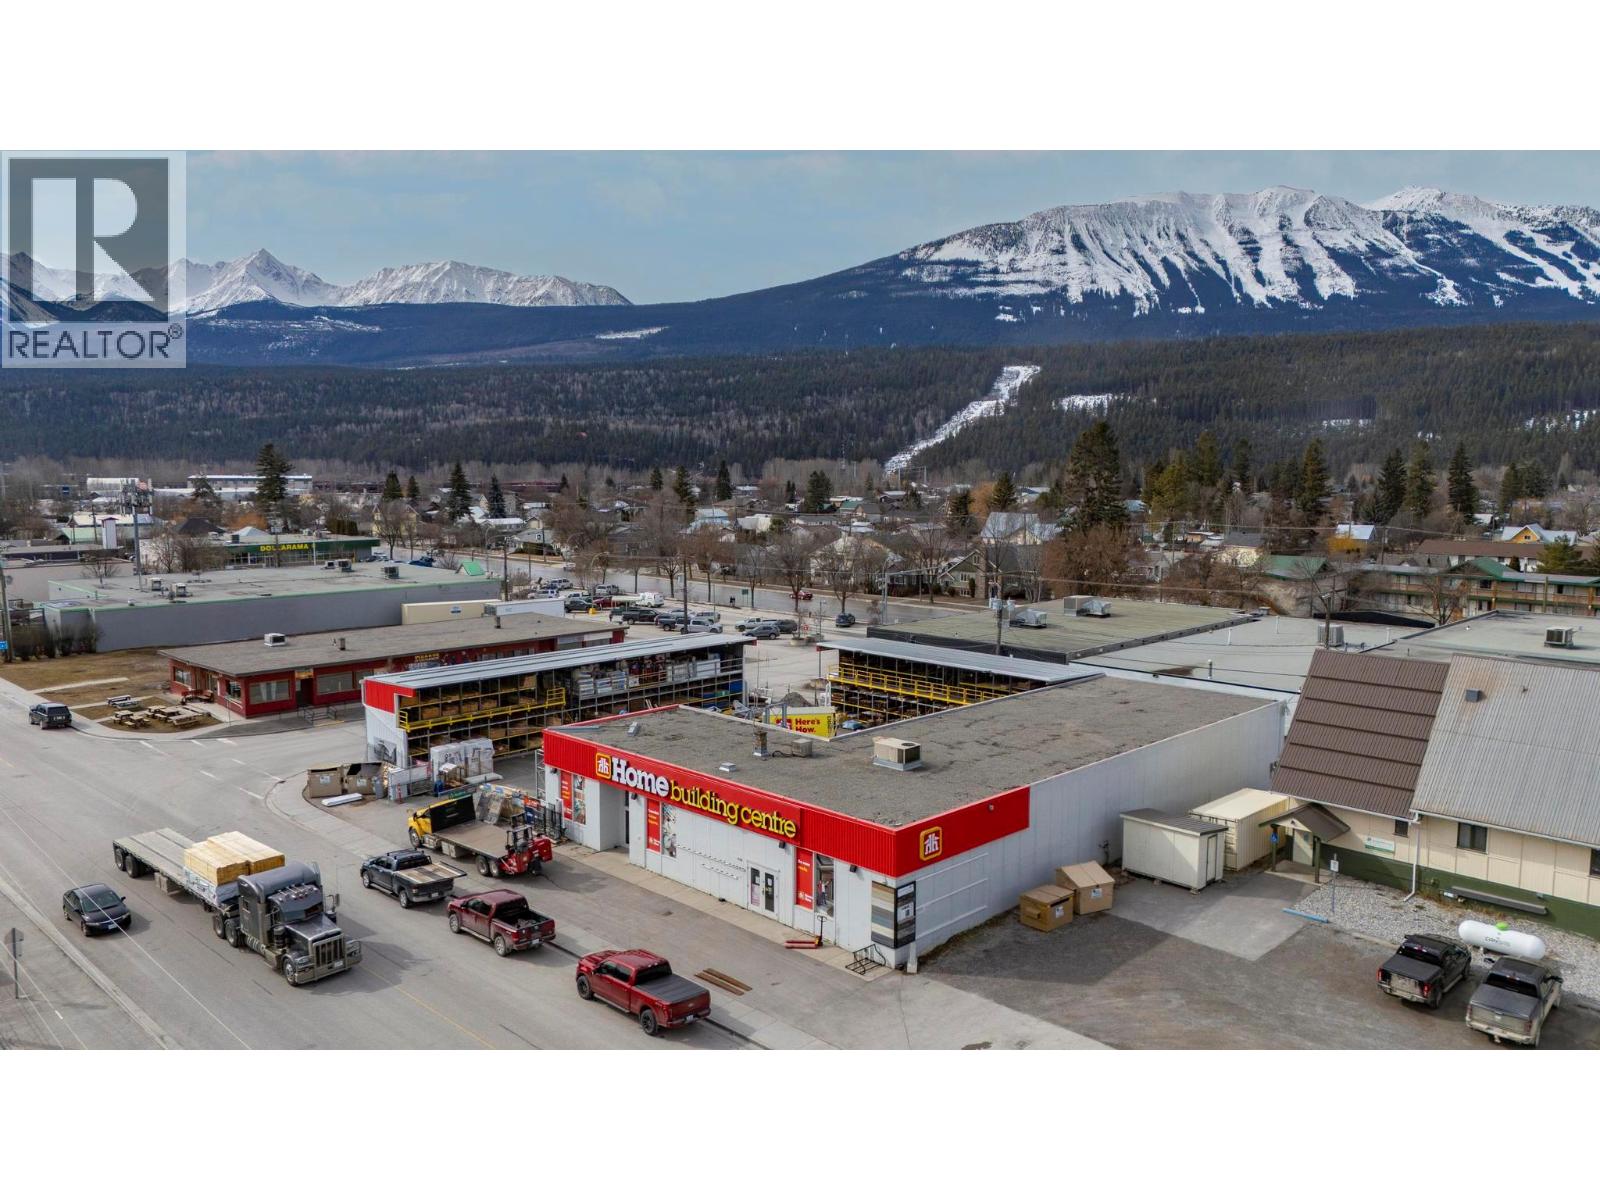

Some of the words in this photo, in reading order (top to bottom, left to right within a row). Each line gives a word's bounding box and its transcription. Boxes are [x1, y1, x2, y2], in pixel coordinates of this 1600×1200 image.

[611, 757, 669, 797] Home
[671, 780, 738, 825] building
[741, 807, 796, 838] centre
